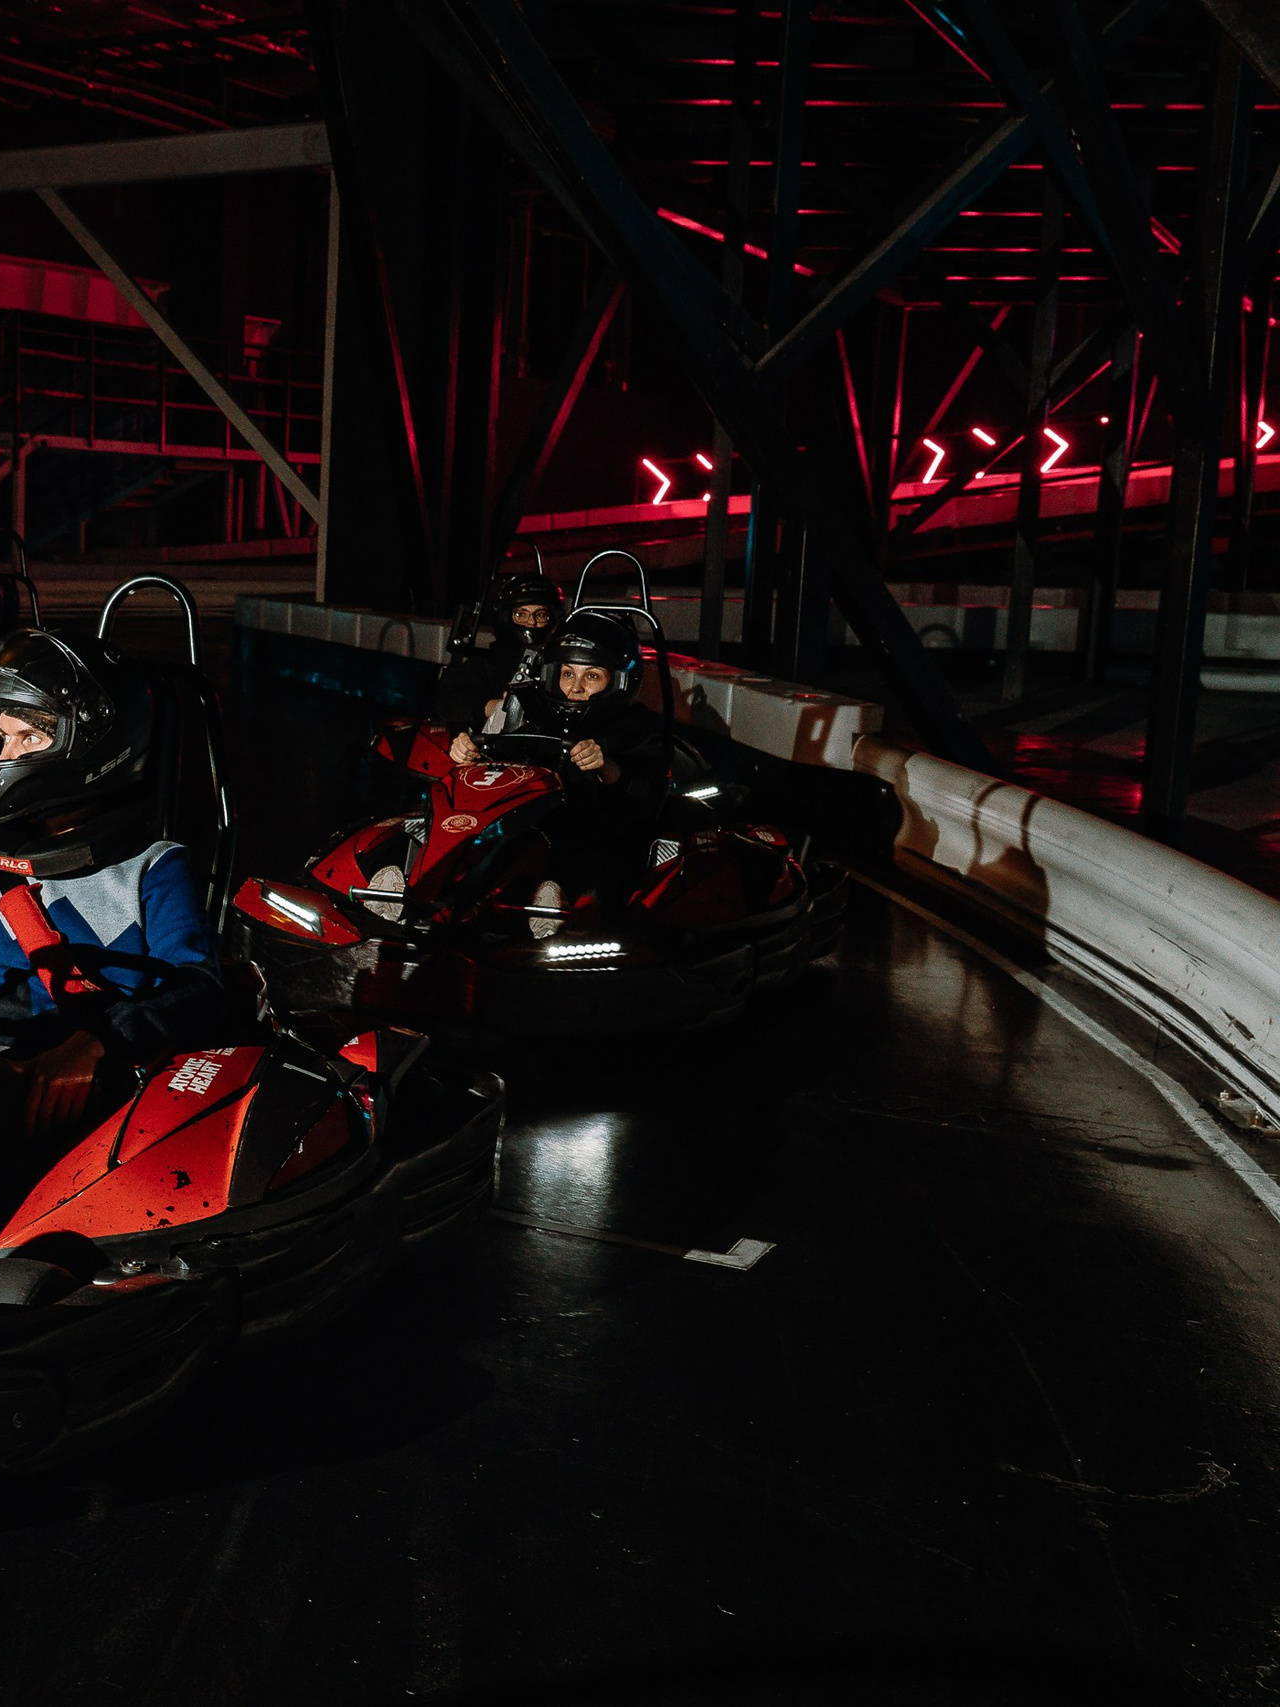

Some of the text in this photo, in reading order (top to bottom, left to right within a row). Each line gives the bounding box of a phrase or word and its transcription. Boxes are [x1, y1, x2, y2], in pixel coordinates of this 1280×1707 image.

[85, 747, 132, 784] LS2
[472, 771, 504, 786] 3
[0, 859, 29, 870] RLG
[168, 1058, 207, 1093] ATOMIC
[187, 1061, 223, 1096] HEART
